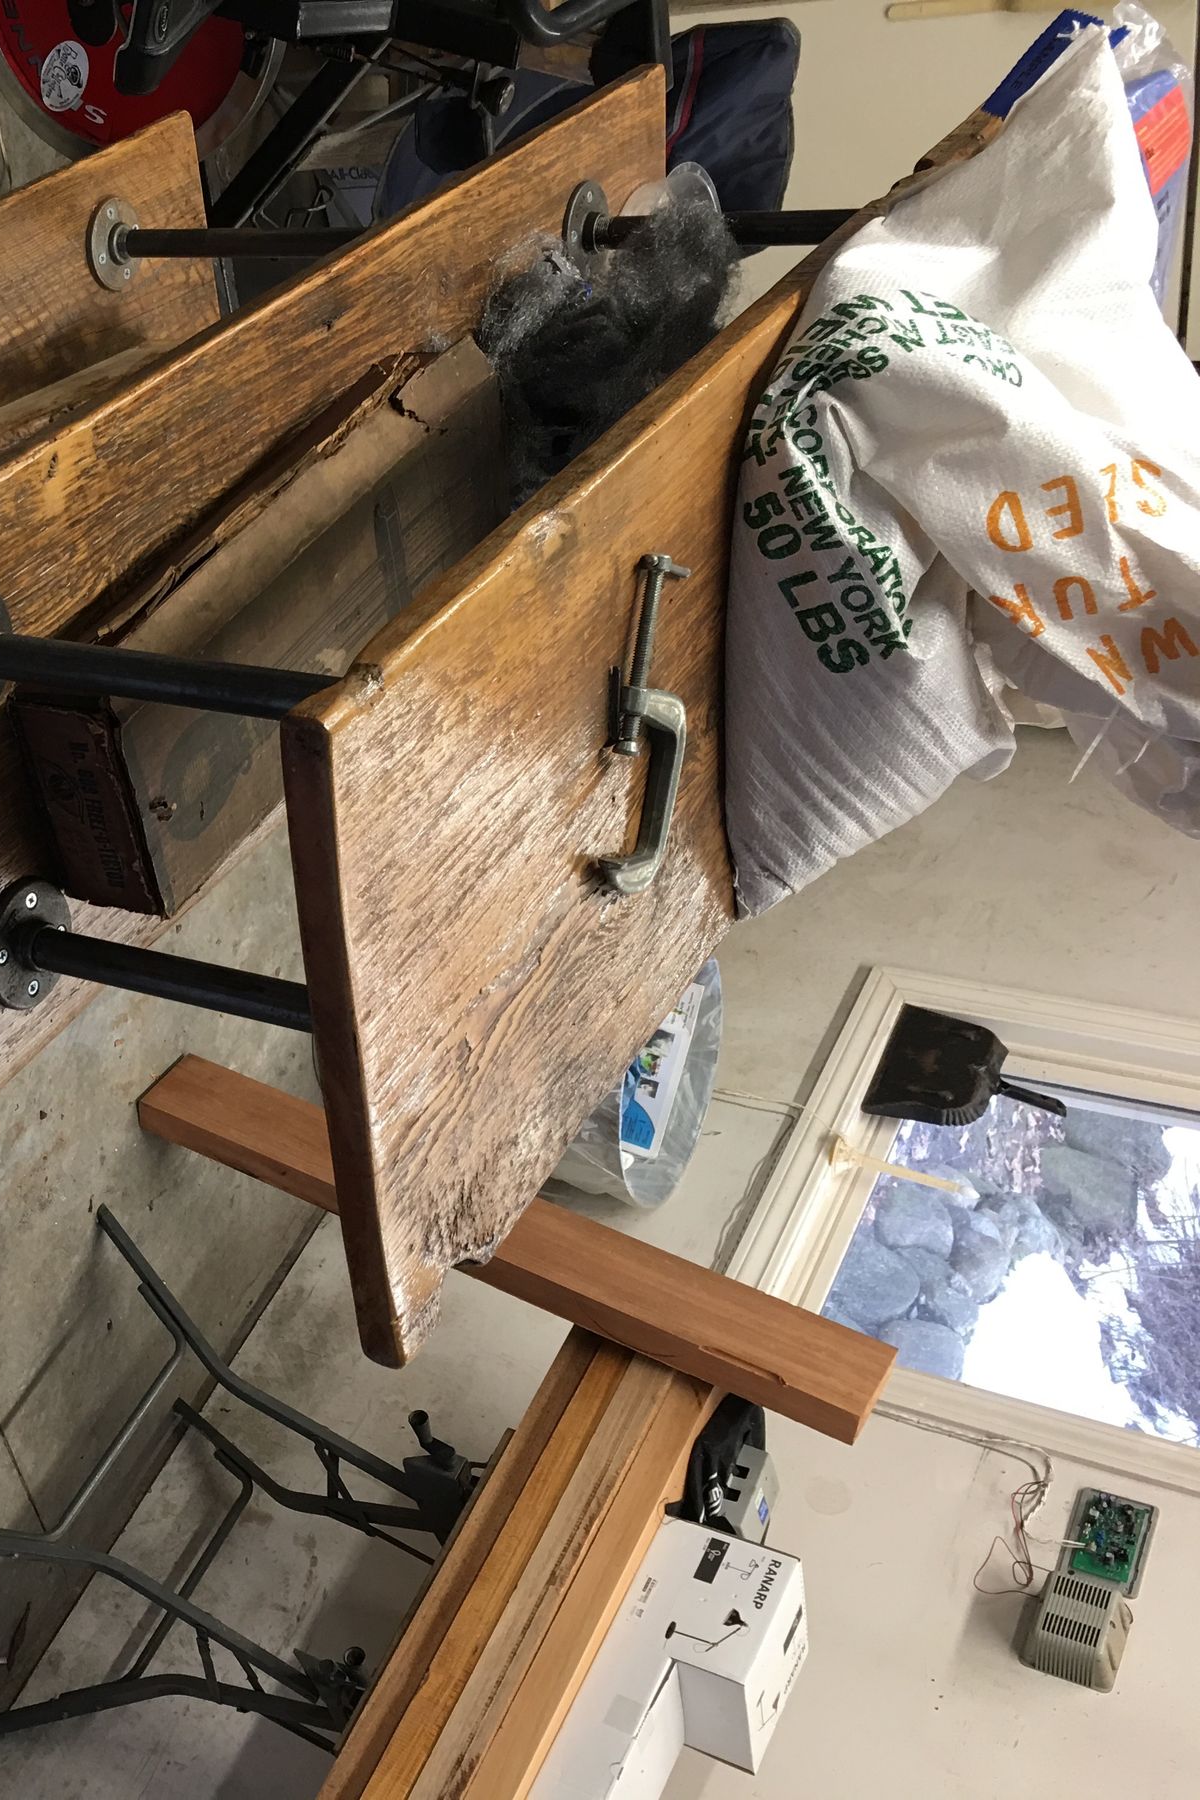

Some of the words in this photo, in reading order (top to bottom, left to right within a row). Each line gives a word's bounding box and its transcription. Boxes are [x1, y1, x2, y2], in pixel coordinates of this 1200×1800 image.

[743, 491, 801, 560] 50
[777, 570, 870, 674] LBS
[778, 464, 845, 552] NEW
[827, 556, 909, 660] YORK
[752, 1559, 782, 1610] RANARP
